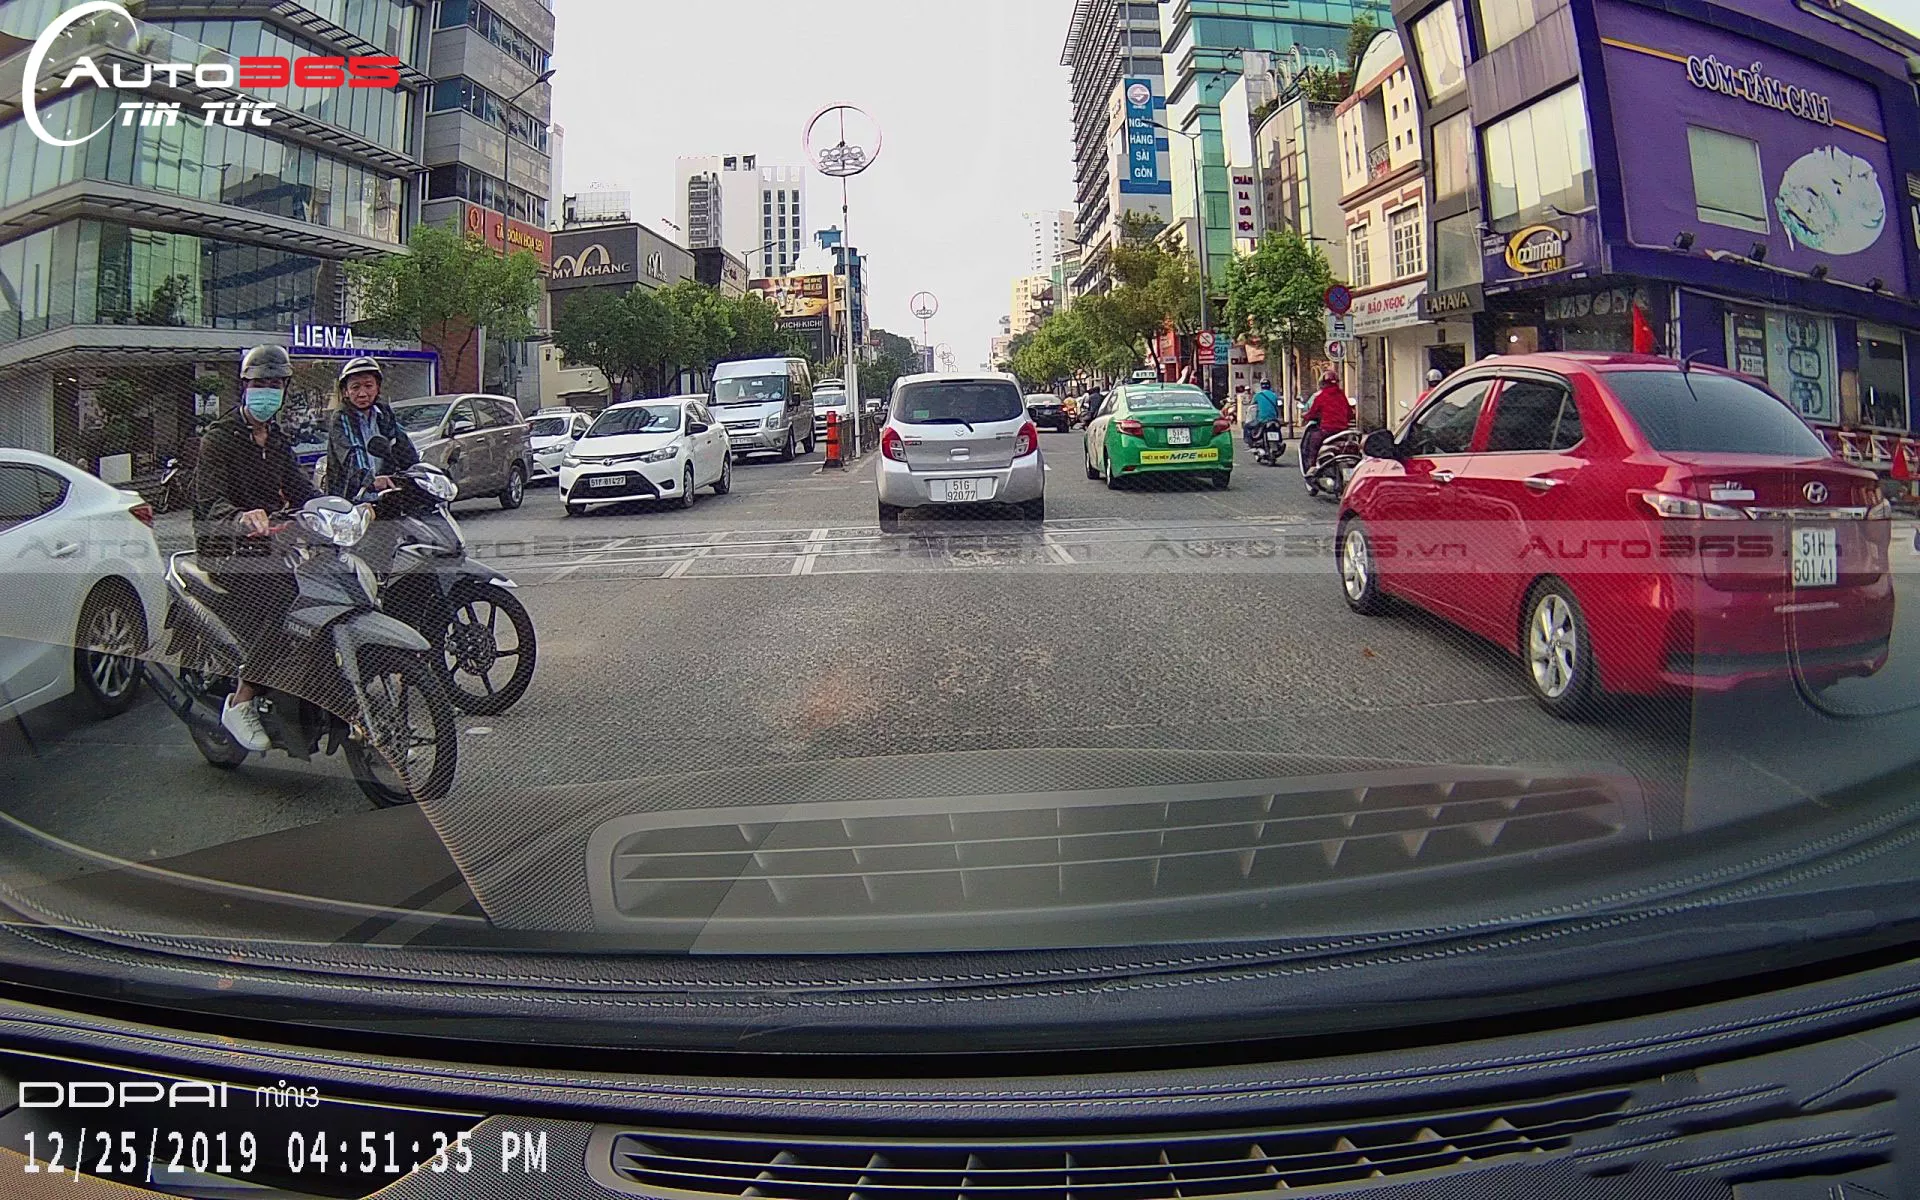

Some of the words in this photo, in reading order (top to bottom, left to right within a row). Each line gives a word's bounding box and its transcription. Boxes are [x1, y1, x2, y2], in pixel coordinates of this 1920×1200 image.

[1686, 54, 1739, 98] CƠM
[1738, 61, 1786, 112] TẤM
[1786, 84, 1835, 127] CALI
[1129, 133, 1154, 146] HÀNG
[1135, 148, 1150, 162] SÀI
[1134, 164, 1153, 179] GÒN
[583, 262, 631, 276] KHANG
[1170, 452, 1197, 461] MPE
[953, 481, 970, 491] 51G
[947, 491, 977, 501] 920.77
[1802, 532, 1827, 557] 51H
[1794, 559, 1834, 584] 501.41
